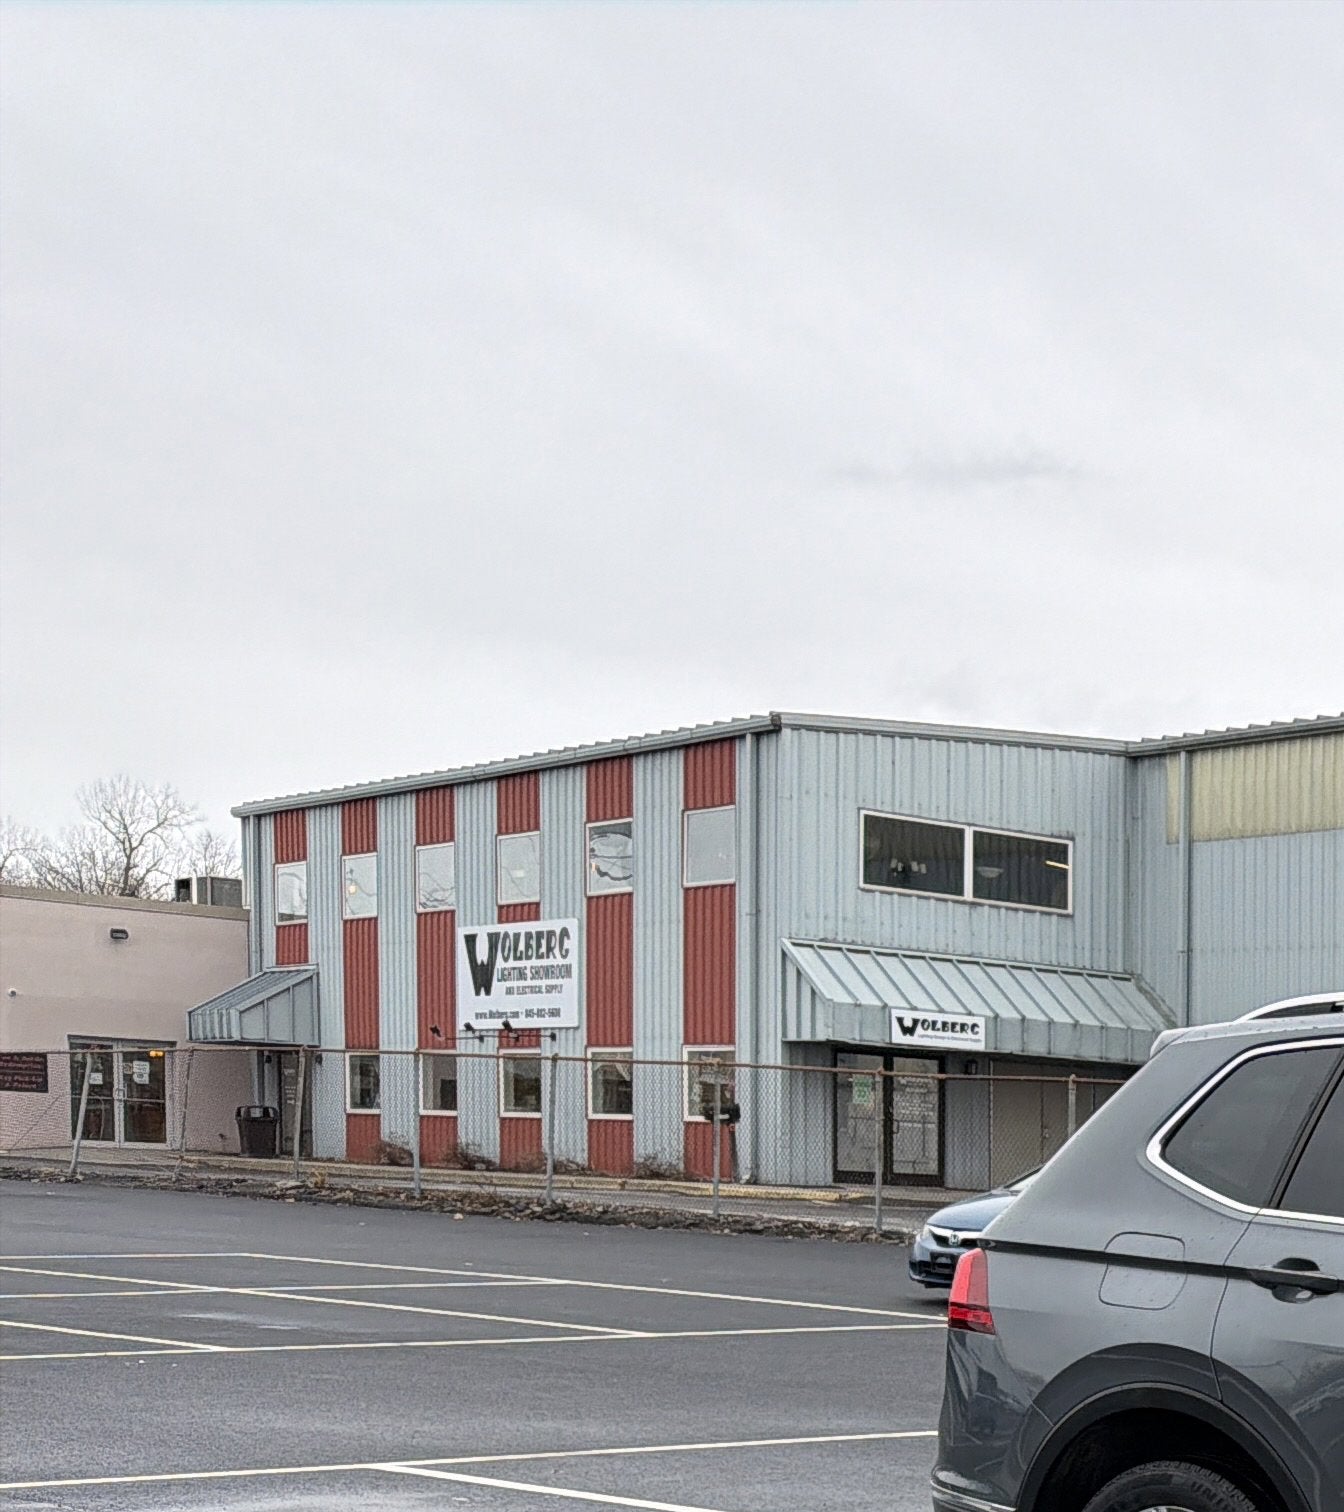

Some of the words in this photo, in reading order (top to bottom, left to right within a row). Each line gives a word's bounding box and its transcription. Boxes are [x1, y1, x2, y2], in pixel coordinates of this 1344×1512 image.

[464, 927, 571, 996] WOLBERG
[497, 966, 528, 982] LIGHTING
[530, 964, 573, 980] SHOWROOM
[895, 1016, 980, 1037] WOLBERG
